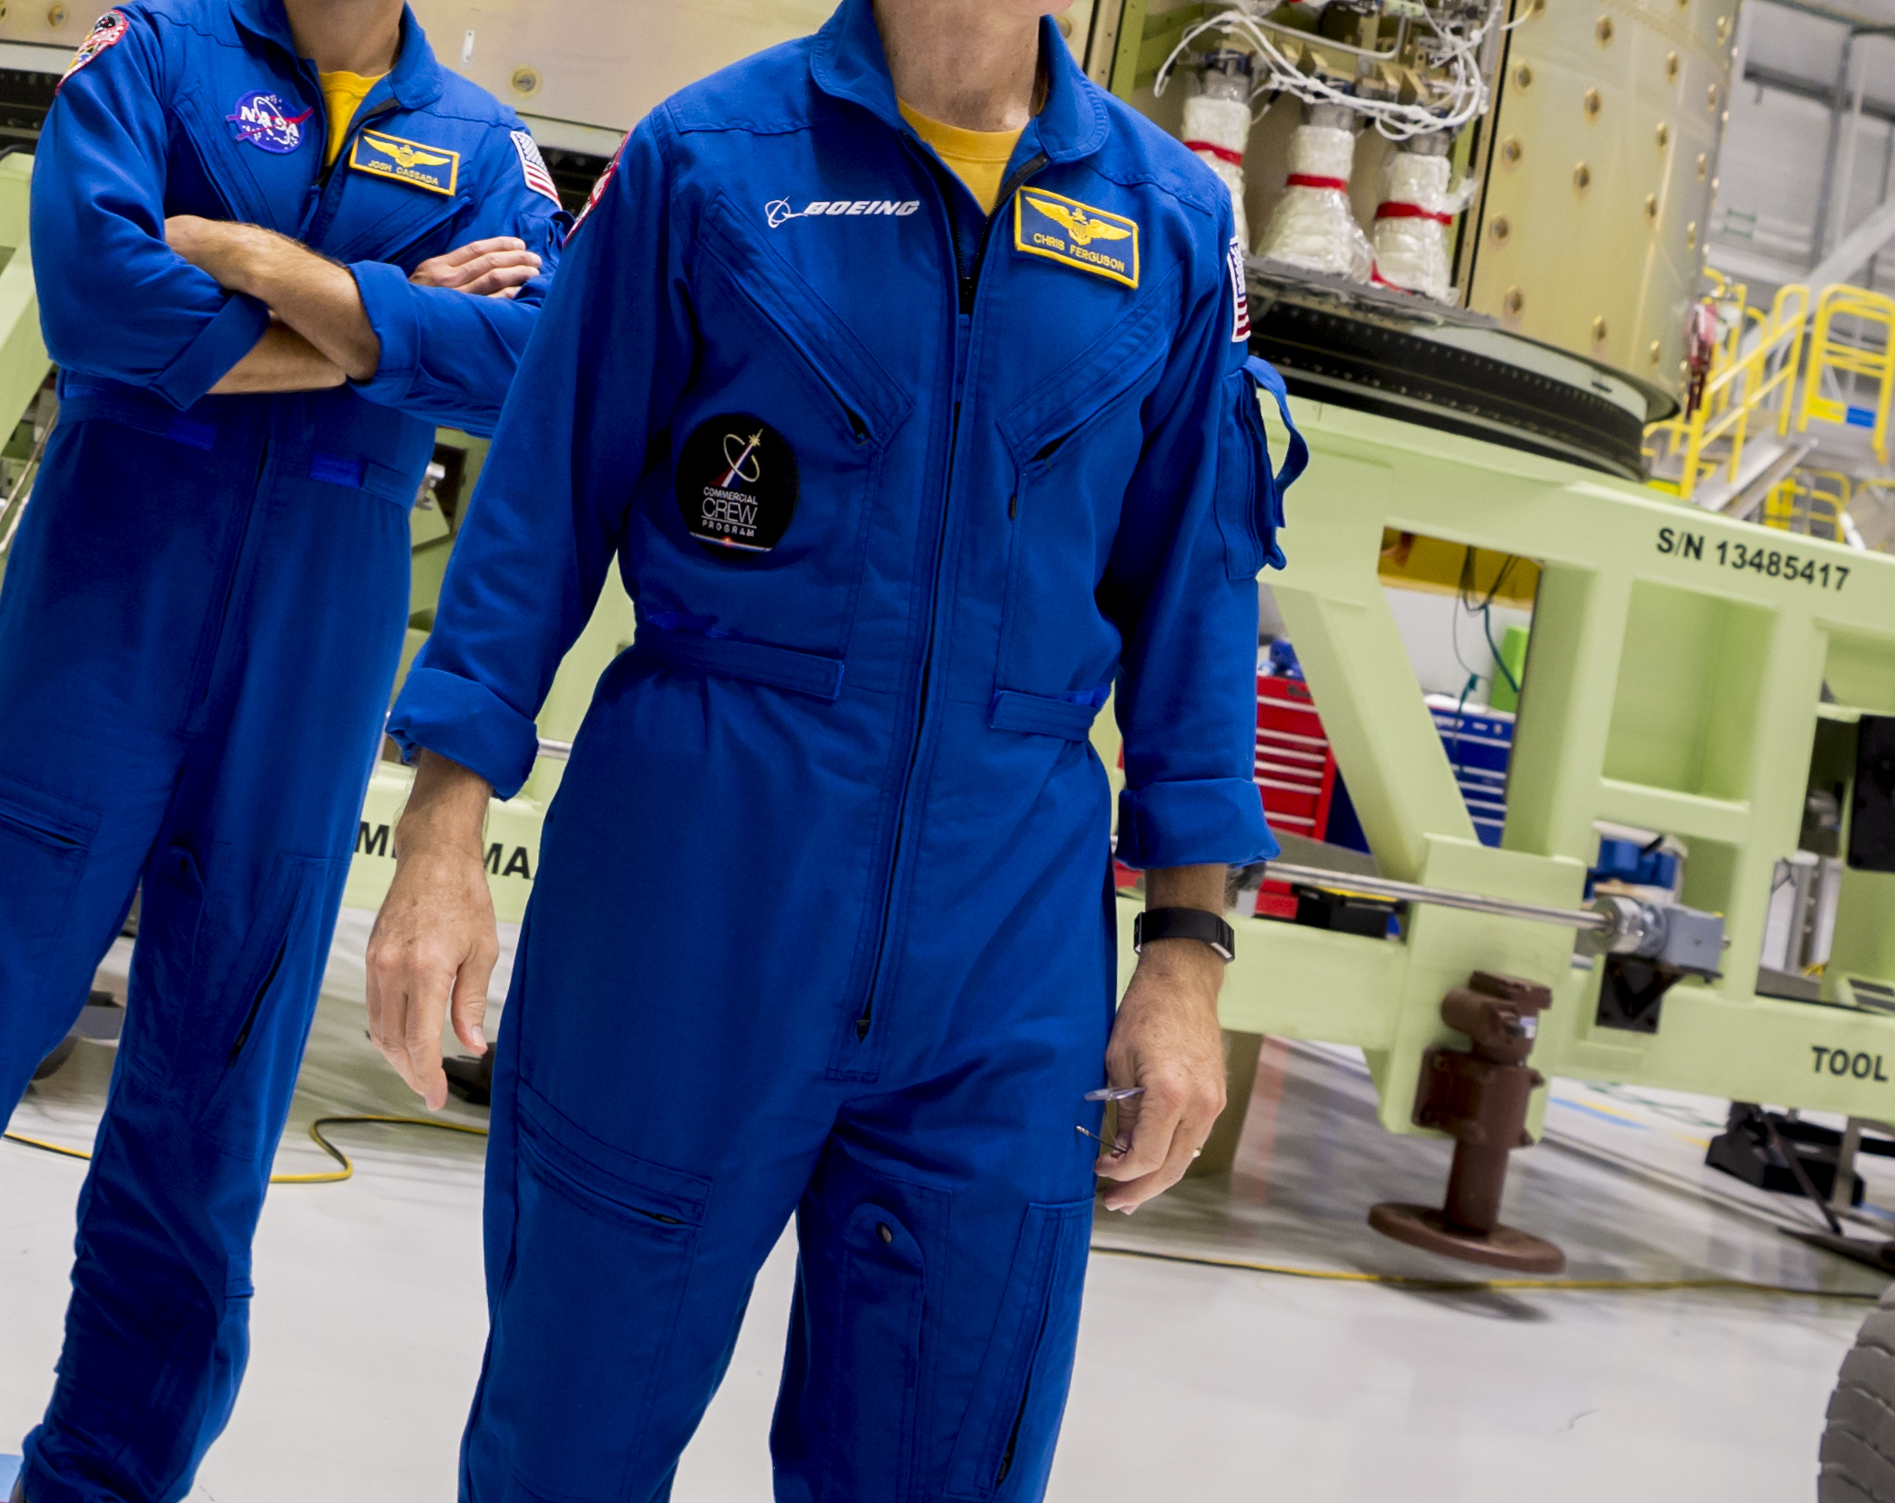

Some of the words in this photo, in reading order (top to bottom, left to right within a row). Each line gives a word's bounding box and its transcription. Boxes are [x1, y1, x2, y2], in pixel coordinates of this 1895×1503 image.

[240, 105, 300, 138] NASA
[803, 200, 920, 216] BOEING
[1033, 233, 1065, 251] CHRIS
[1070, 244, 1125, 272] FERGUSON
[703, 486, 758, 505] COMMERCIAL
[702, 497, 758, 525] CREW
[702, 519, 755, 537] PROGRAM
[1657, 528, 1704, 560] S/N
[1716, 541, 1851, 591] 13485417
[1811, 1045, 1889, 1083] TOOL
